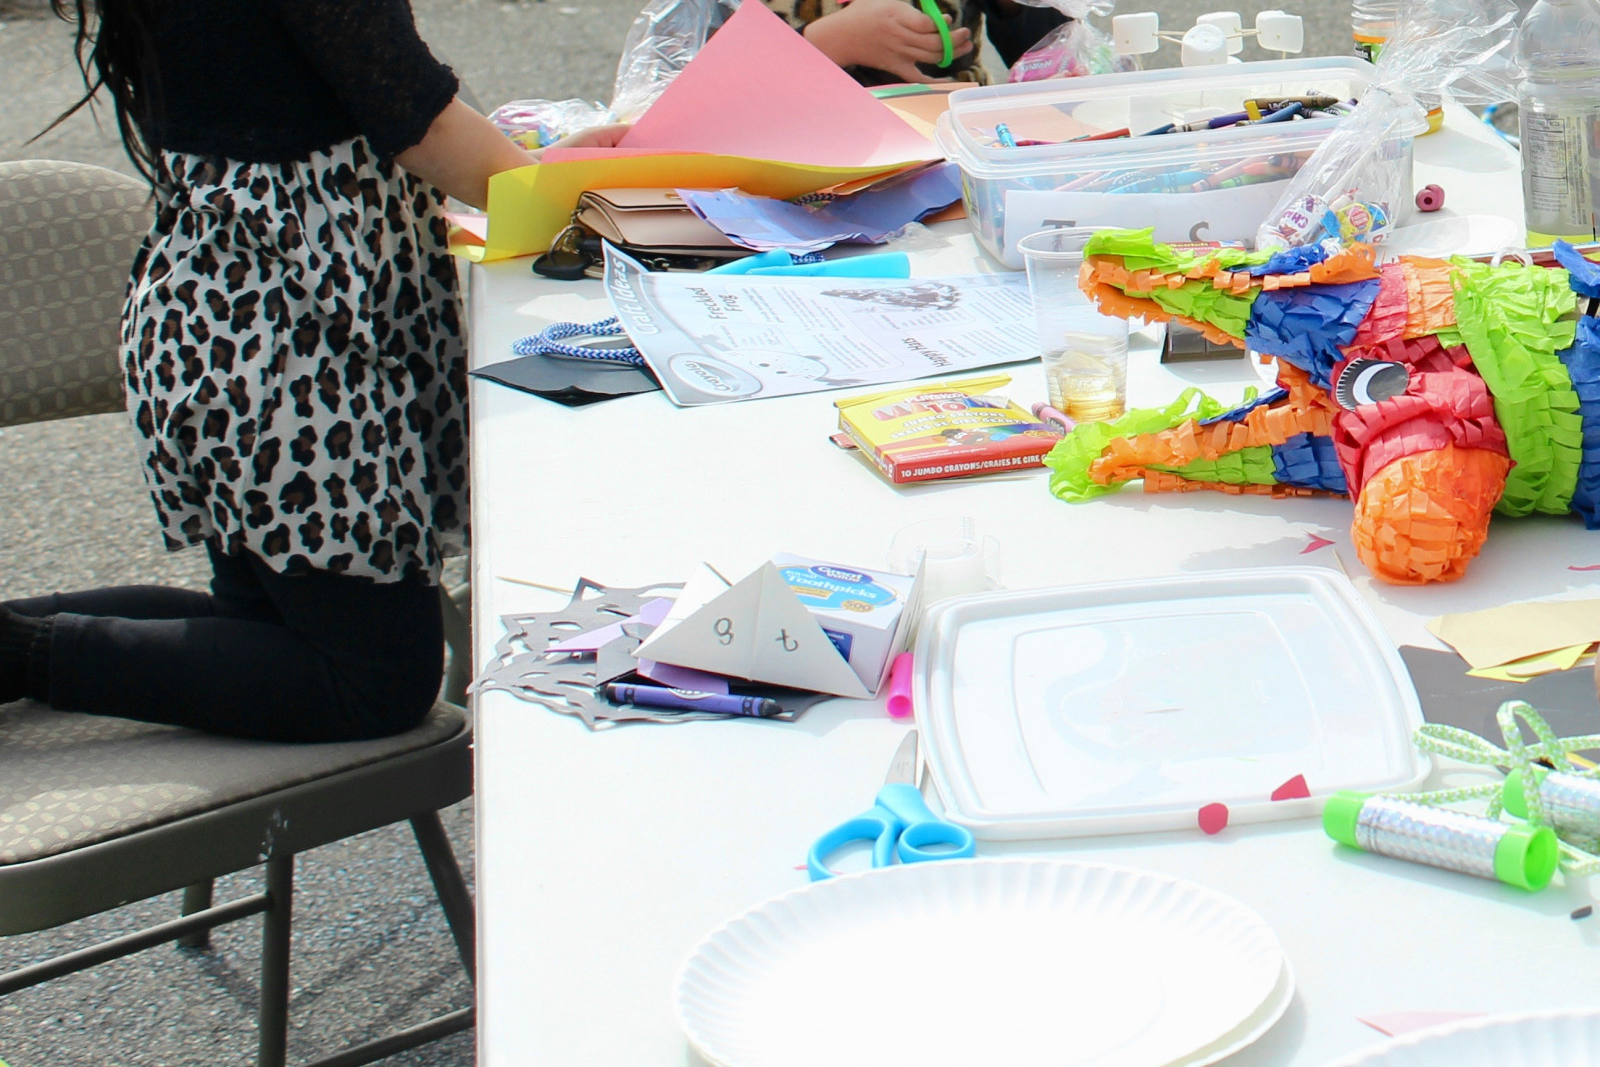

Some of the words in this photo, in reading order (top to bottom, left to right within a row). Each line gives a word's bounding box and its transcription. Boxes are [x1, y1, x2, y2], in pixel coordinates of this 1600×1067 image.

[610, 257, 638, 303] Ideas
[684, 286, 728, 320] Freckled
[718, 293, 743, 313] Frog
[620, 302, 661, 335] Craft
[901, 337, 922, 352] Hats
[919, 349, 953, 368] Happy
[684, 360, 732, 393] Crayola
[927, 402, 968, 414] 10
[903, 412, 949, 428] JUMBO
[901, 469, 912, 478] 10
[913, 465, 943, 478] JUMBO
[1012, 457, 1022, 466] DE
[1023, 455, 1040, 465] CIRE
[817, 565, 864, 581] Great
[787, 575, 878, 600] Toothpicks
[846, 600, 872, 611] 500
